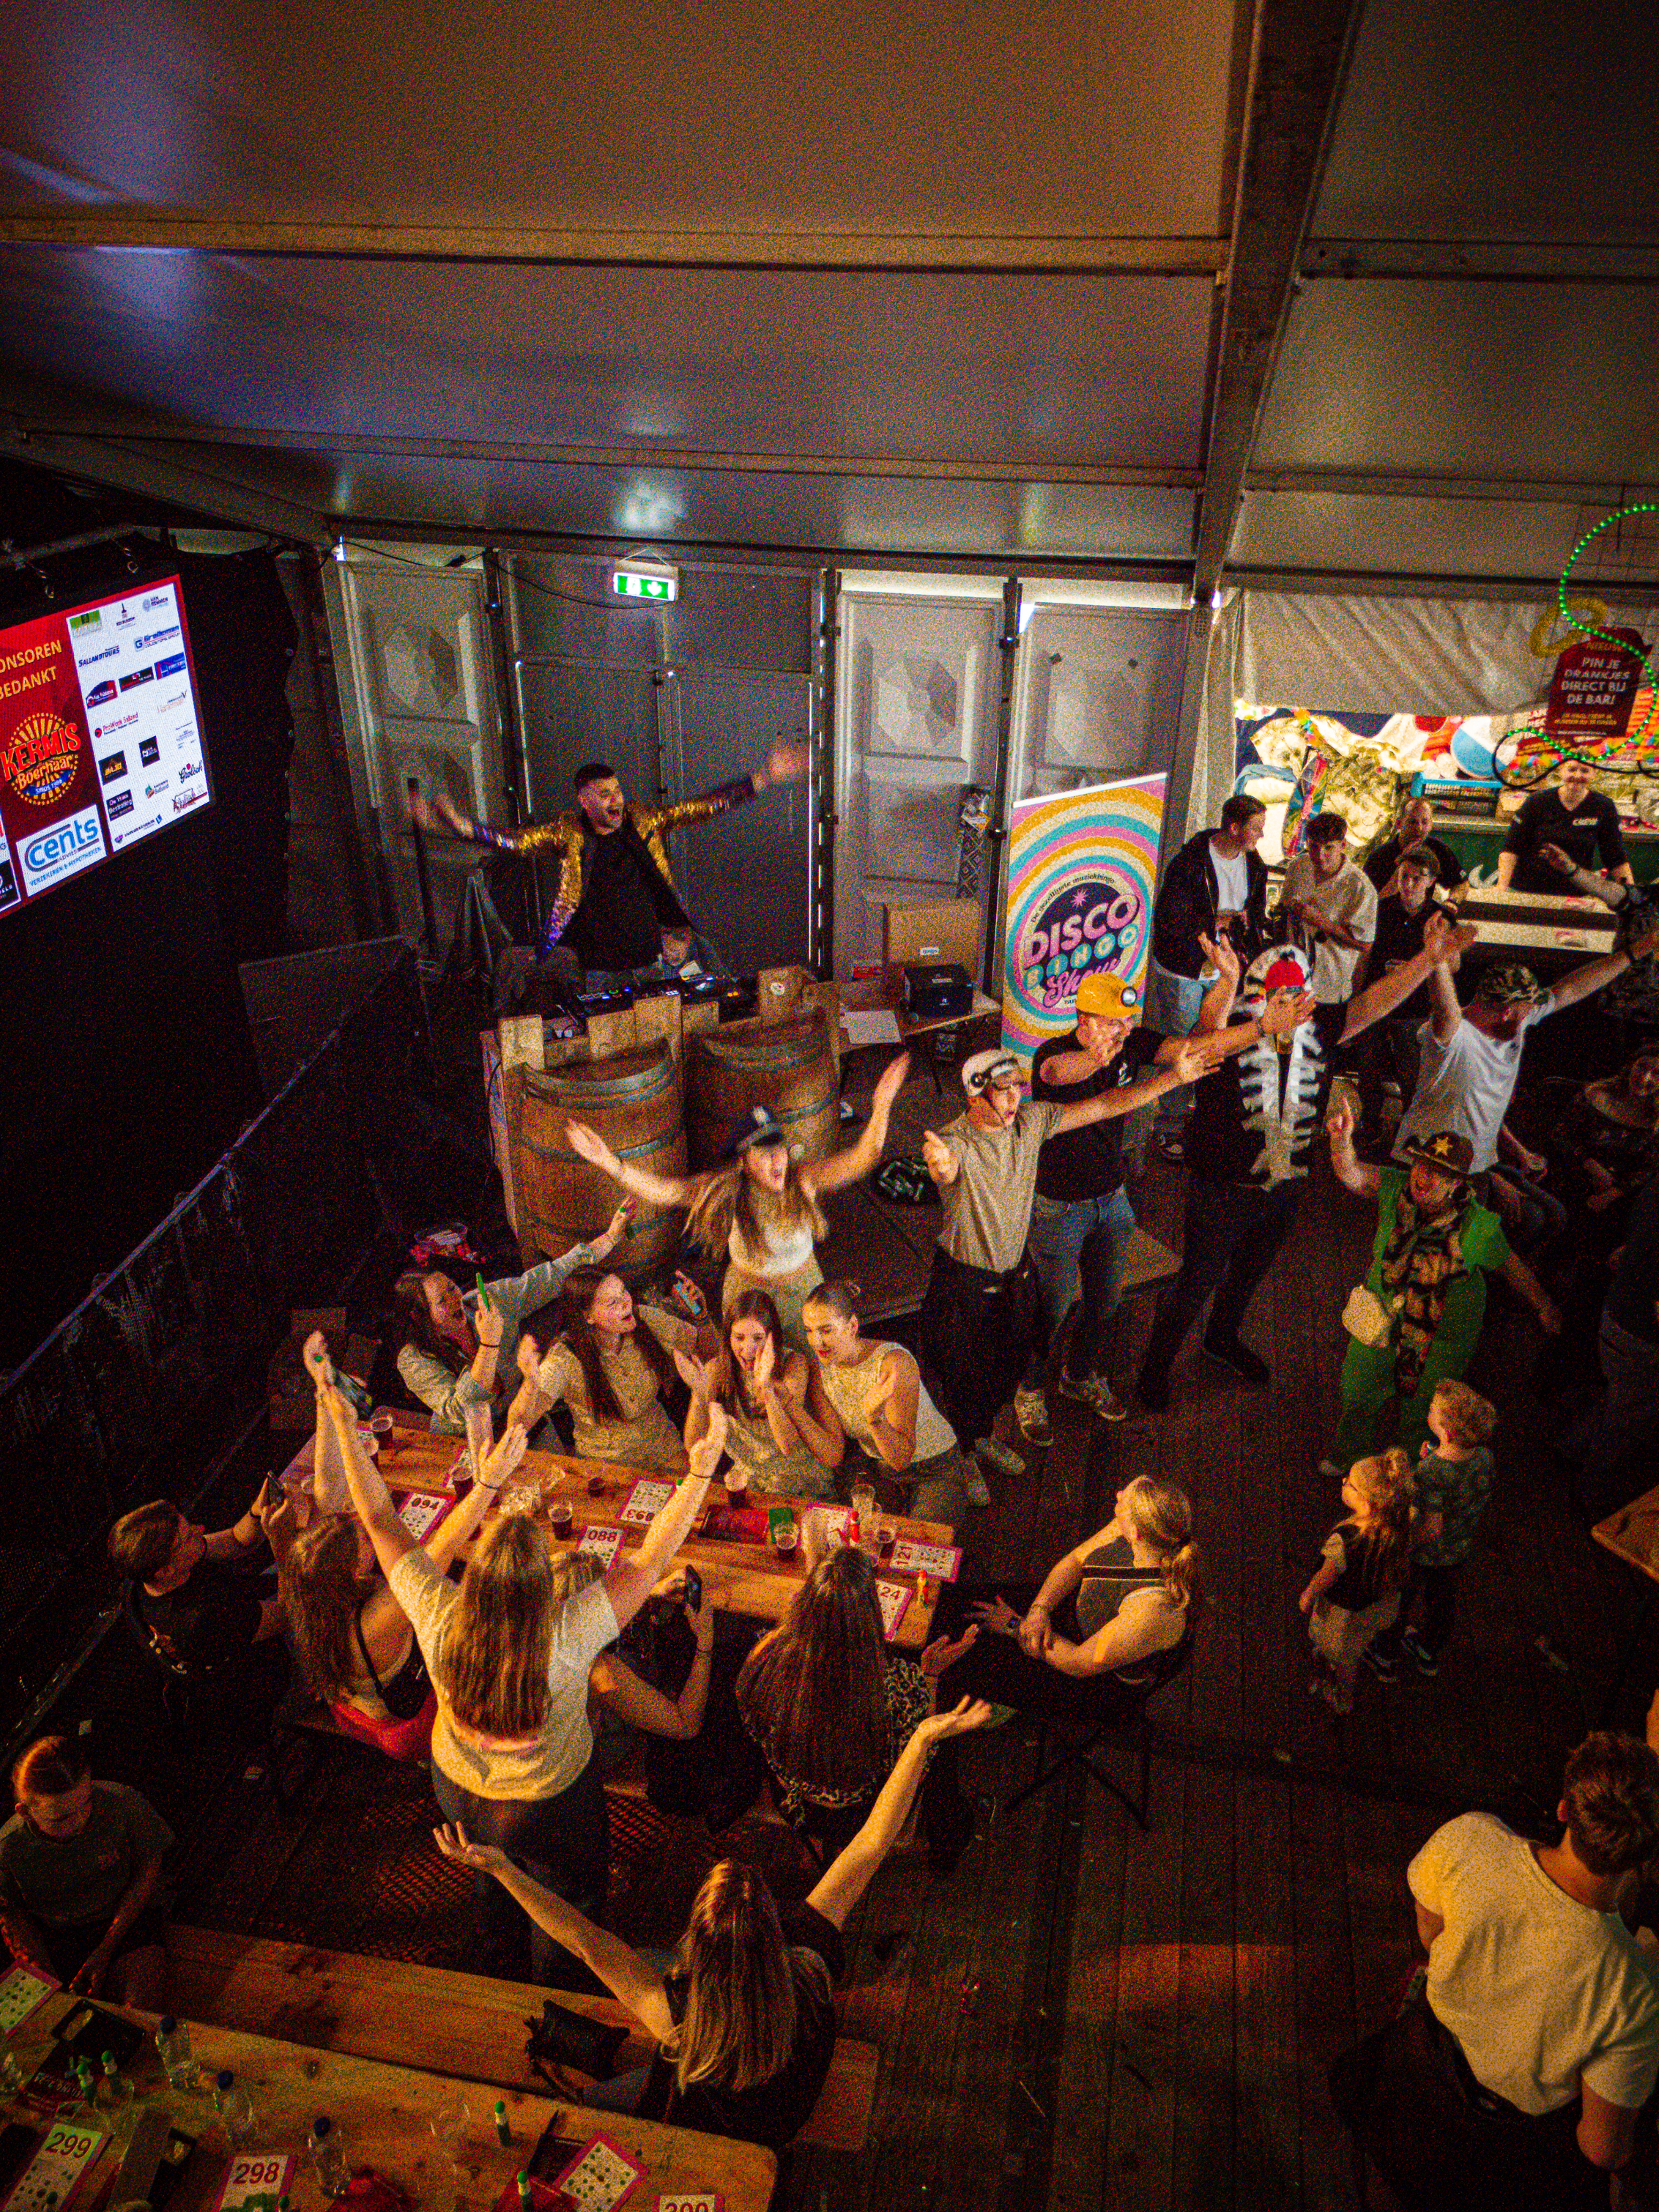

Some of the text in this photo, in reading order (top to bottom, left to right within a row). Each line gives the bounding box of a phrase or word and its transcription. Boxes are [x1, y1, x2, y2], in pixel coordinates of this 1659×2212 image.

[1581, 657, 1622, 669] PIN JE
[1564, 669, 1631, 680] DRANKJES
[1561, 680, 1628, 693] DIRECT BIJ
[1567, 694, 1617, 705] DE BAR!
[0, 722, 81, 782] KERMIS
[17, 755, 73, 790] Boerhaar
[179, 760, 203, 784] Grolsch
[29, 819, 98, 866] cents
[1023, 893, 1140, 970] DISCO
[1024, 924, 1138, 989] BINGO
[410, 1497, 439, 1510] 094
[587, 1529, 617, 1543] 088
[896, 1546, 913, 1565] 121
[877, 1585, 900, 1600] 24
[45, 2132, 92, 2159] 299
[232, 2162, 279, 2185] 298
